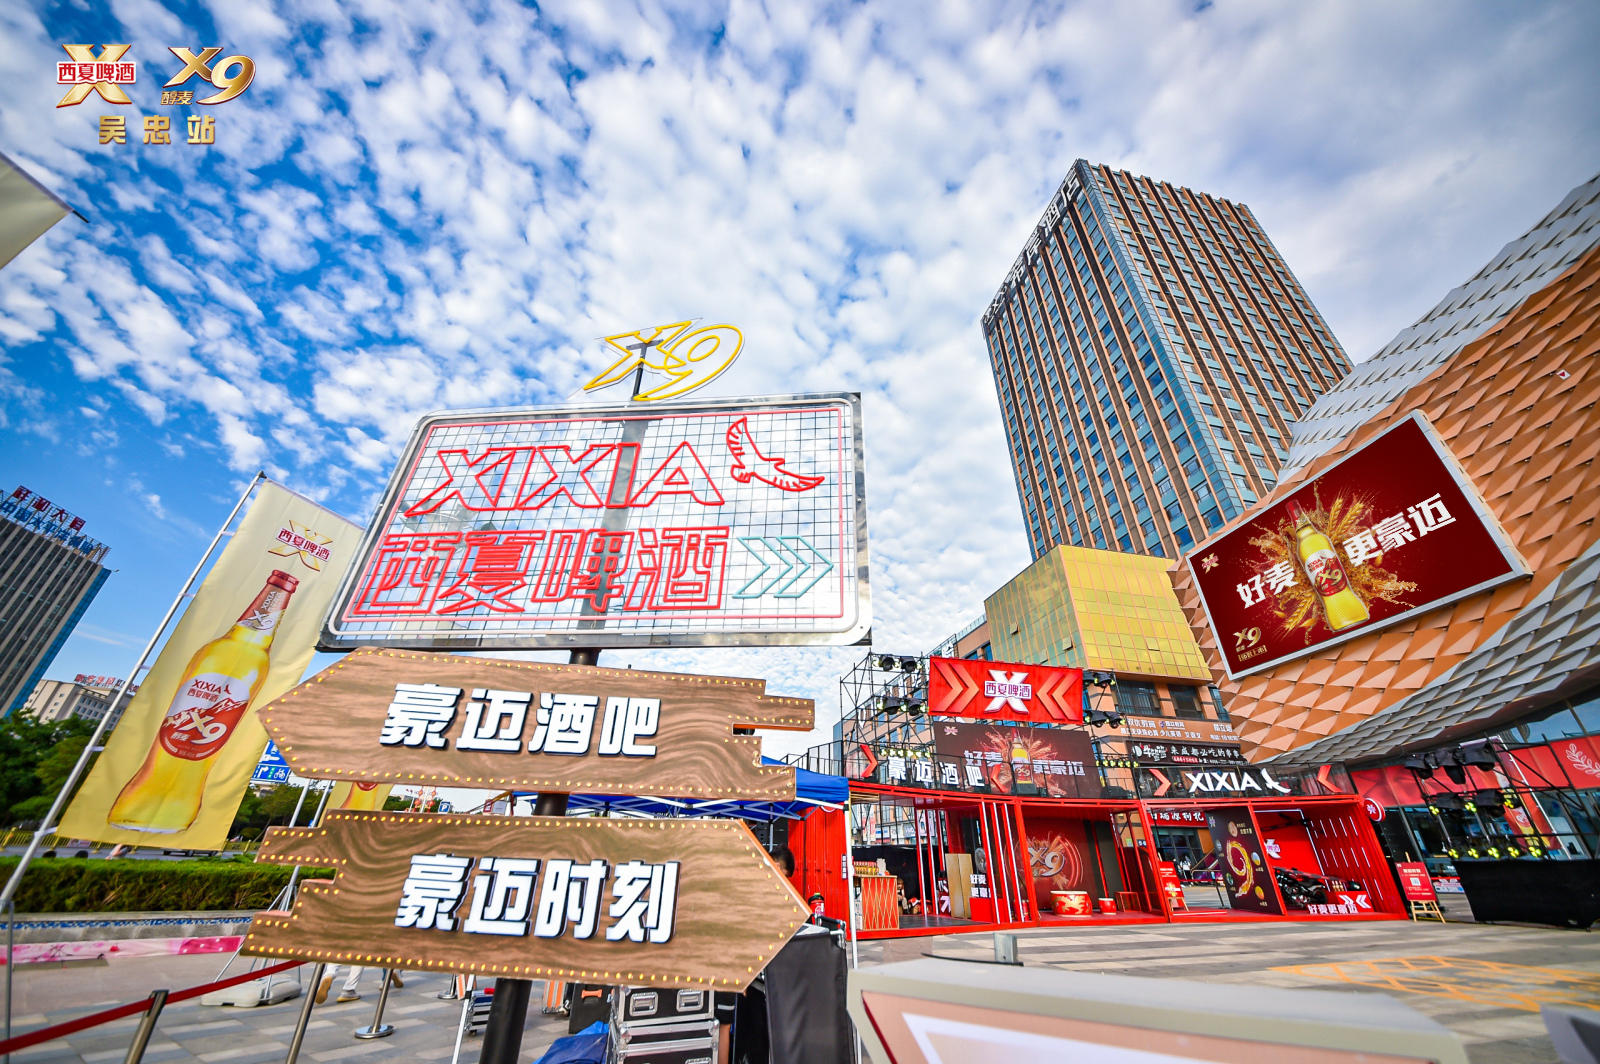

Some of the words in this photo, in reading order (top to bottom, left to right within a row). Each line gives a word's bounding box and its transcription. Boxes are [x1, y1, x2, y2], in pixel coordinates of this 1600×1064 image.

[584, 319, 744, 401] X9
[404, 441, 725, 517] XIXIA
[278, 528, 331, 560] 西夏啤酒
[1236, 561, 1299, 609] 好麦
[1343, 493, 1456, 567] 更豪迈
[353, 525, 730, 614] 西夏啤酒
[1232, 627, 1262, 648] X9
[192, 679, 222, 694] XIXIA
[986, 682, 1031, 698] 西夏啤酒
[178, 711, 228, 745] X9
[379, 683, 661, 758] 豪迈酒吧
[887, 757, 984, 787] 豪迈酒吧
[964, 750, 1003, 767] 好麦
[1032, 759, 1085, 776] 更豪迈
[1185, 771, 1262, 793] XIXIA
[1028, 847, 1065, 877] X9
[394, 853, 681, 944] 豪迈时刻
